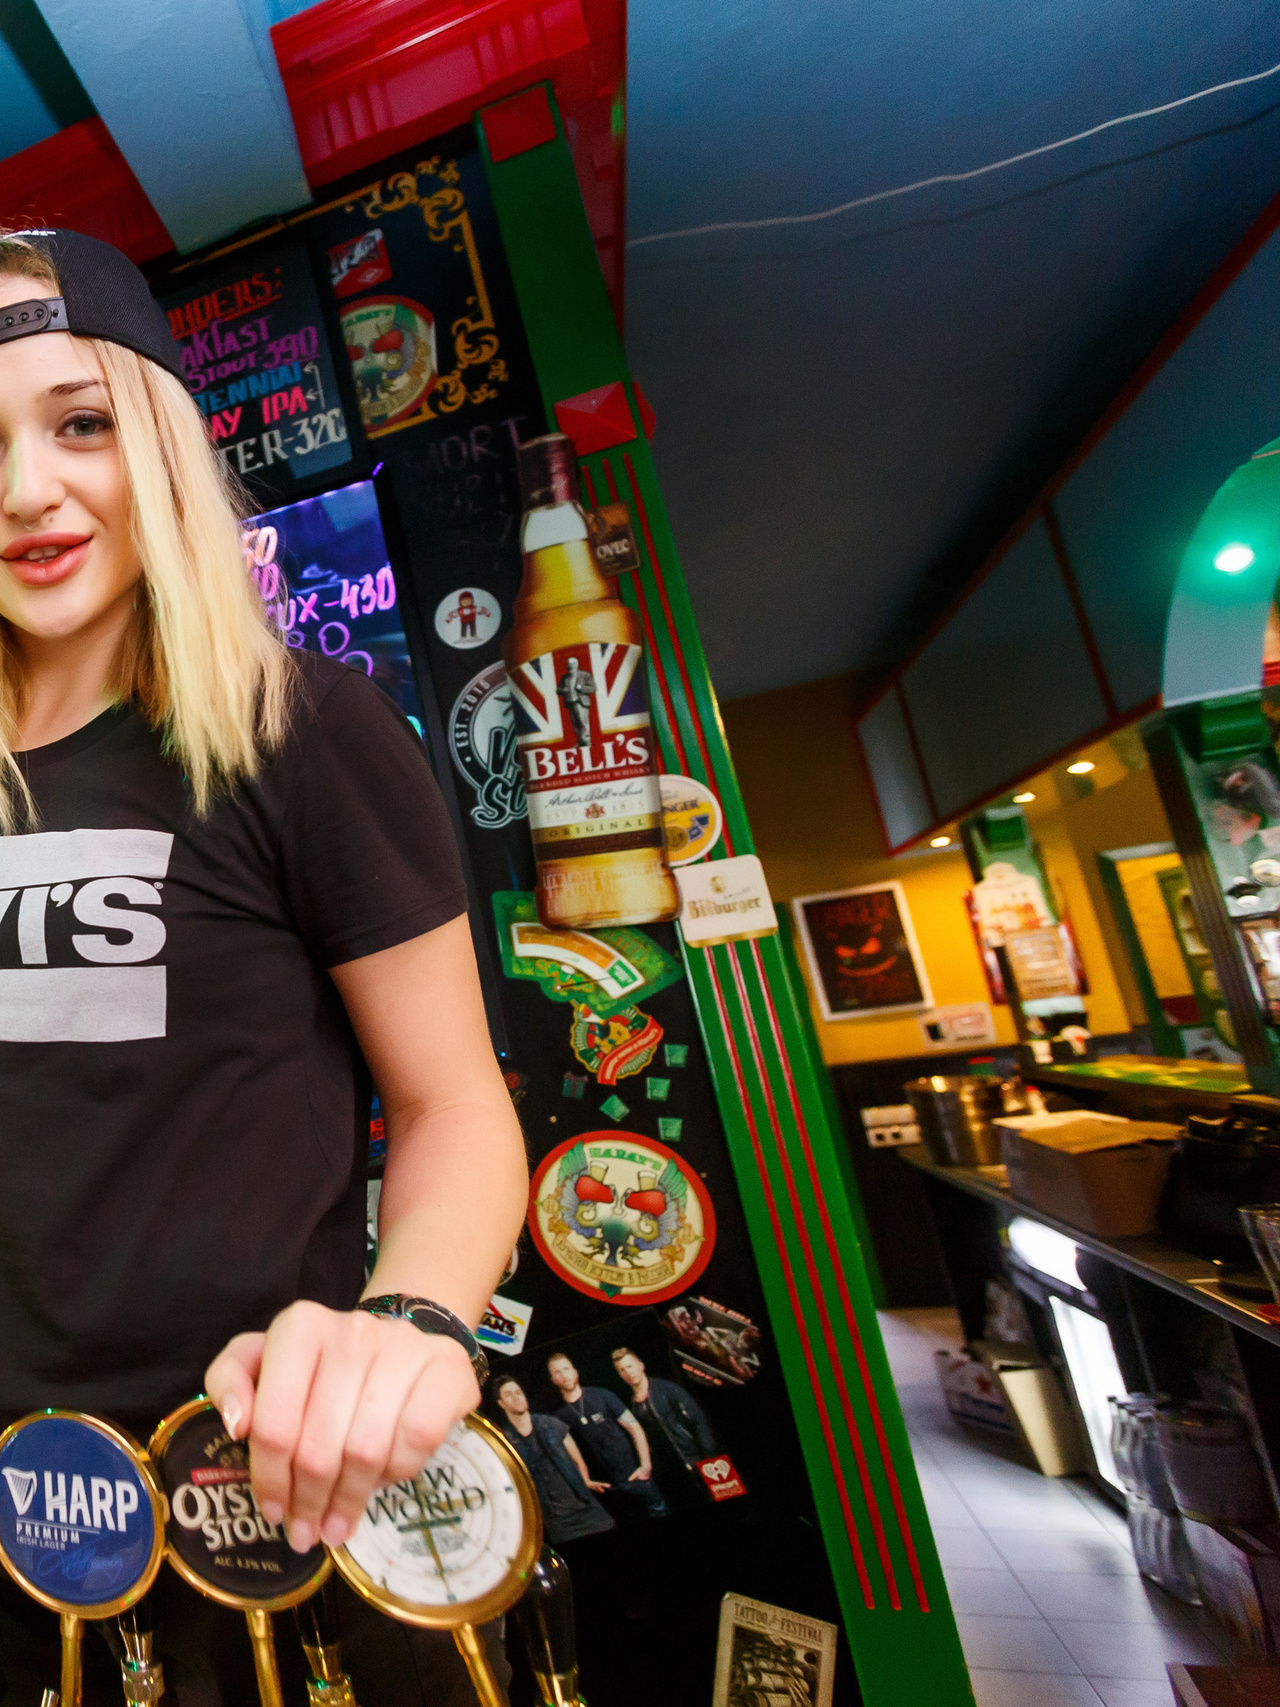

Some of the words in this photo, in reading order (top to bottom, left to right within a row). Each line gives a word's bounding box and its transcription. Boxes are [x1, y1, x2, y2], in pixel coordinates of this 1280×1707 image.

[261, 386, 309, 425] IPA
[524, 733, 650, 782] BELL'S
[549, 818, 644, 838] ORIGINAL
[44, 1470, 139, 1533] HARP
[16, 1522, 80, 1545] PREMIUM
[16, 1535, 38, 1547] IRISH
[39, 1539, 66, 1551] LAGER
[201, 1517, 281, 1552] STOU
